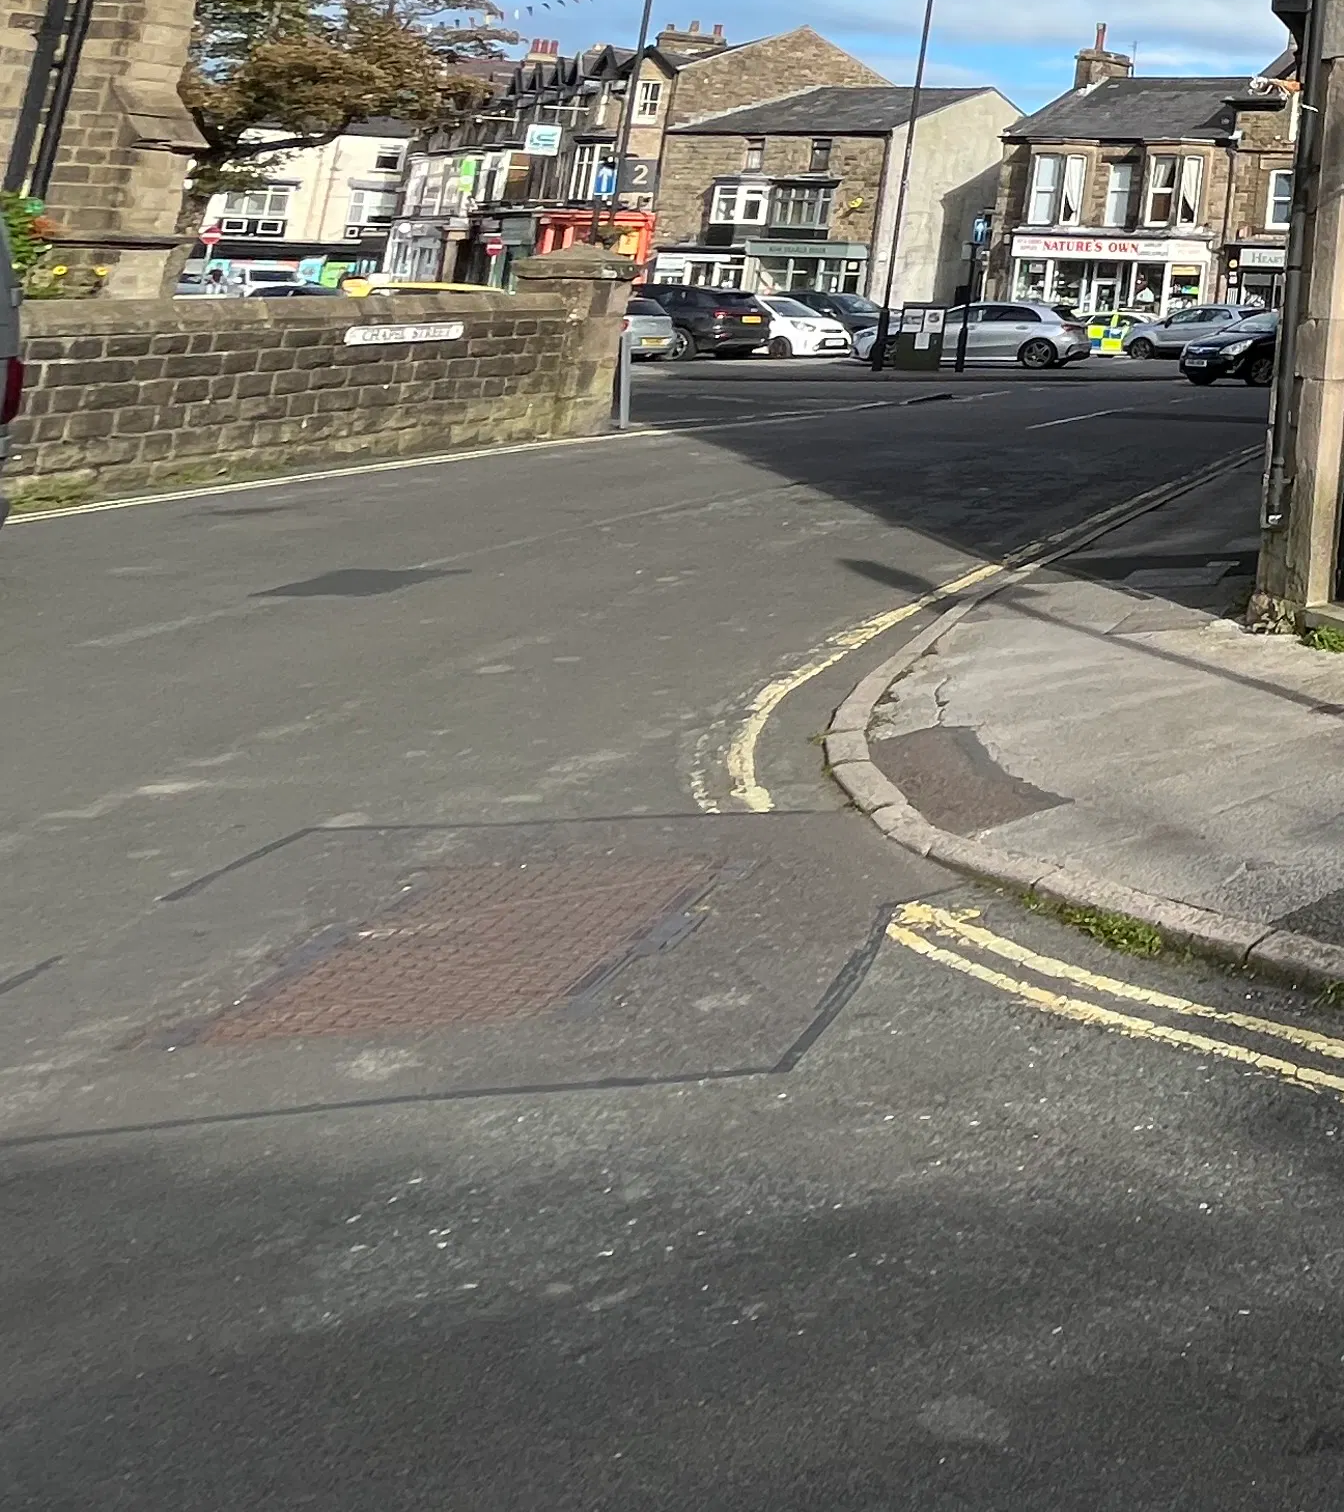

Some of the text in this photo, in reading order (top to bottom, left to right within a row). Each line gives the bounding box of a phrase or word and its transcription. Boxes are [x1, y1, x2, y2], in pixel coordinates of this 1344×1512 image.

[632, 164, 648, 185] 2
[1043, 238, 1103, 253] NATURE'S
[1108, 242, 1139, 256] OWN
